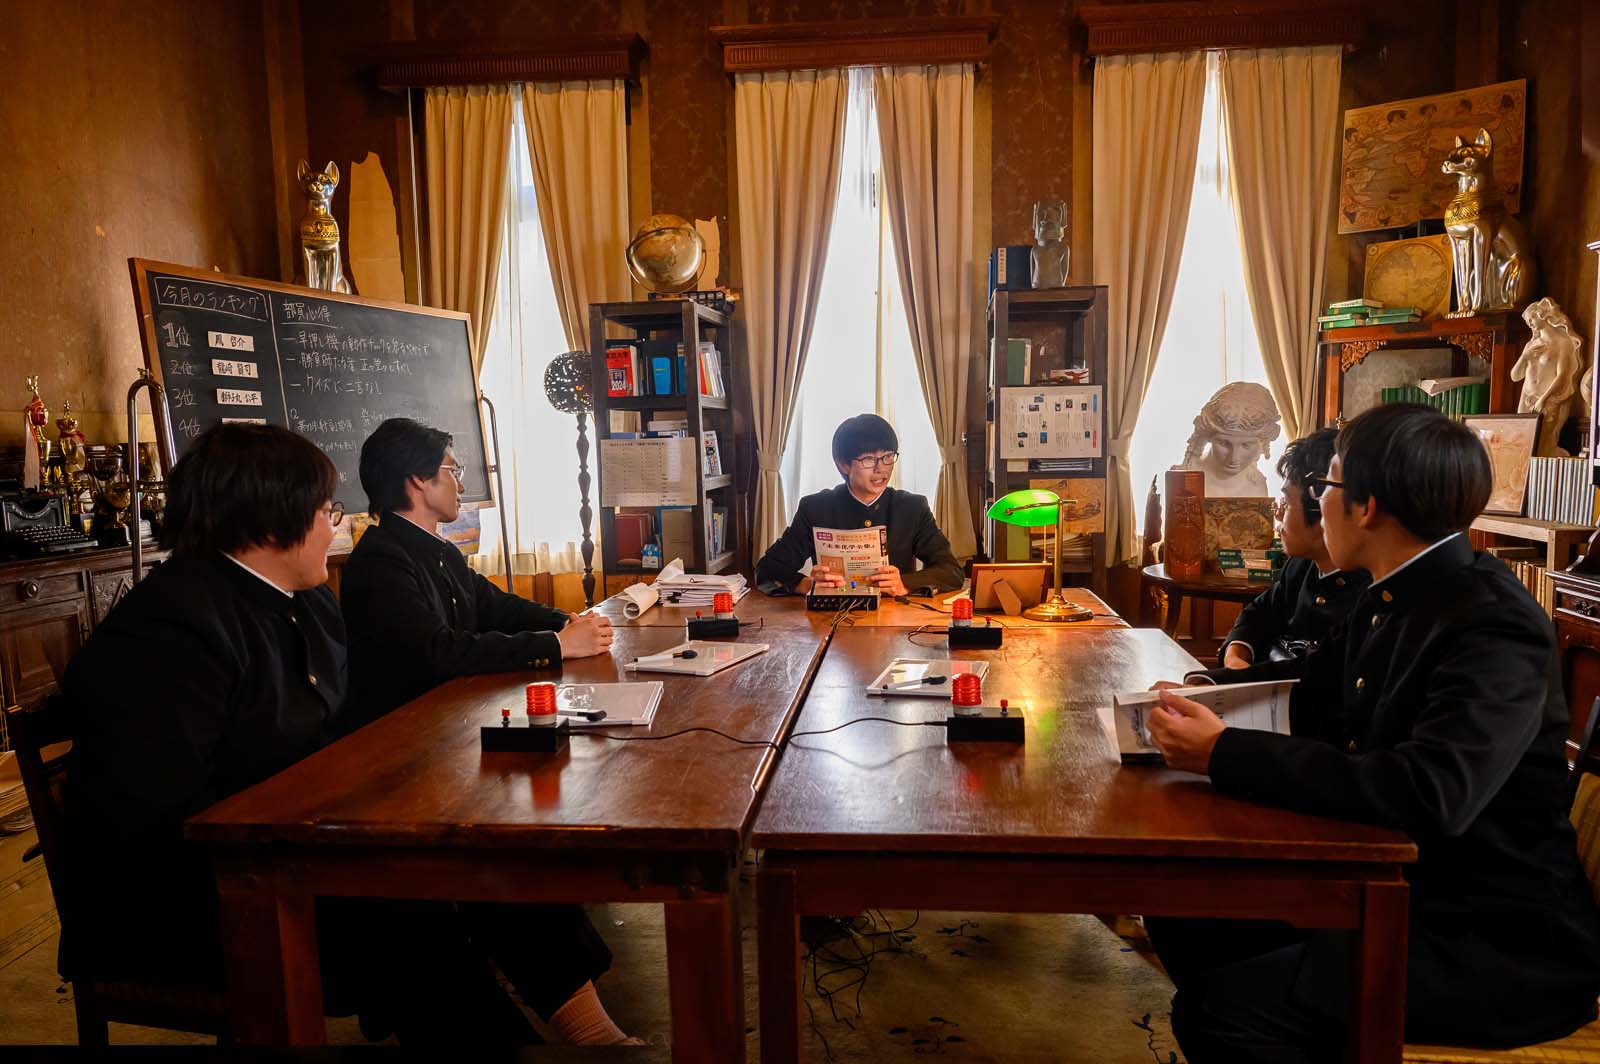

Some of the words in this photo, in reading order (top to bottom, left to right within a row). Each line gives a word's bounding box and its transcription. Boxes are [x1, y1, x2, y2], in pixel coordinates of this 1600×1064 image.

[163, 284, 260, 314] 今月のランキング
[282, 299, 332, 323] 部員心得
[162, 320, 192, 348] 1位
[169, 359, 196, 376] 2位
[171, 387, 199, 408] 3位
[244, 392, 259, 404] 公平
[178, 417, 202, 438] 4位
